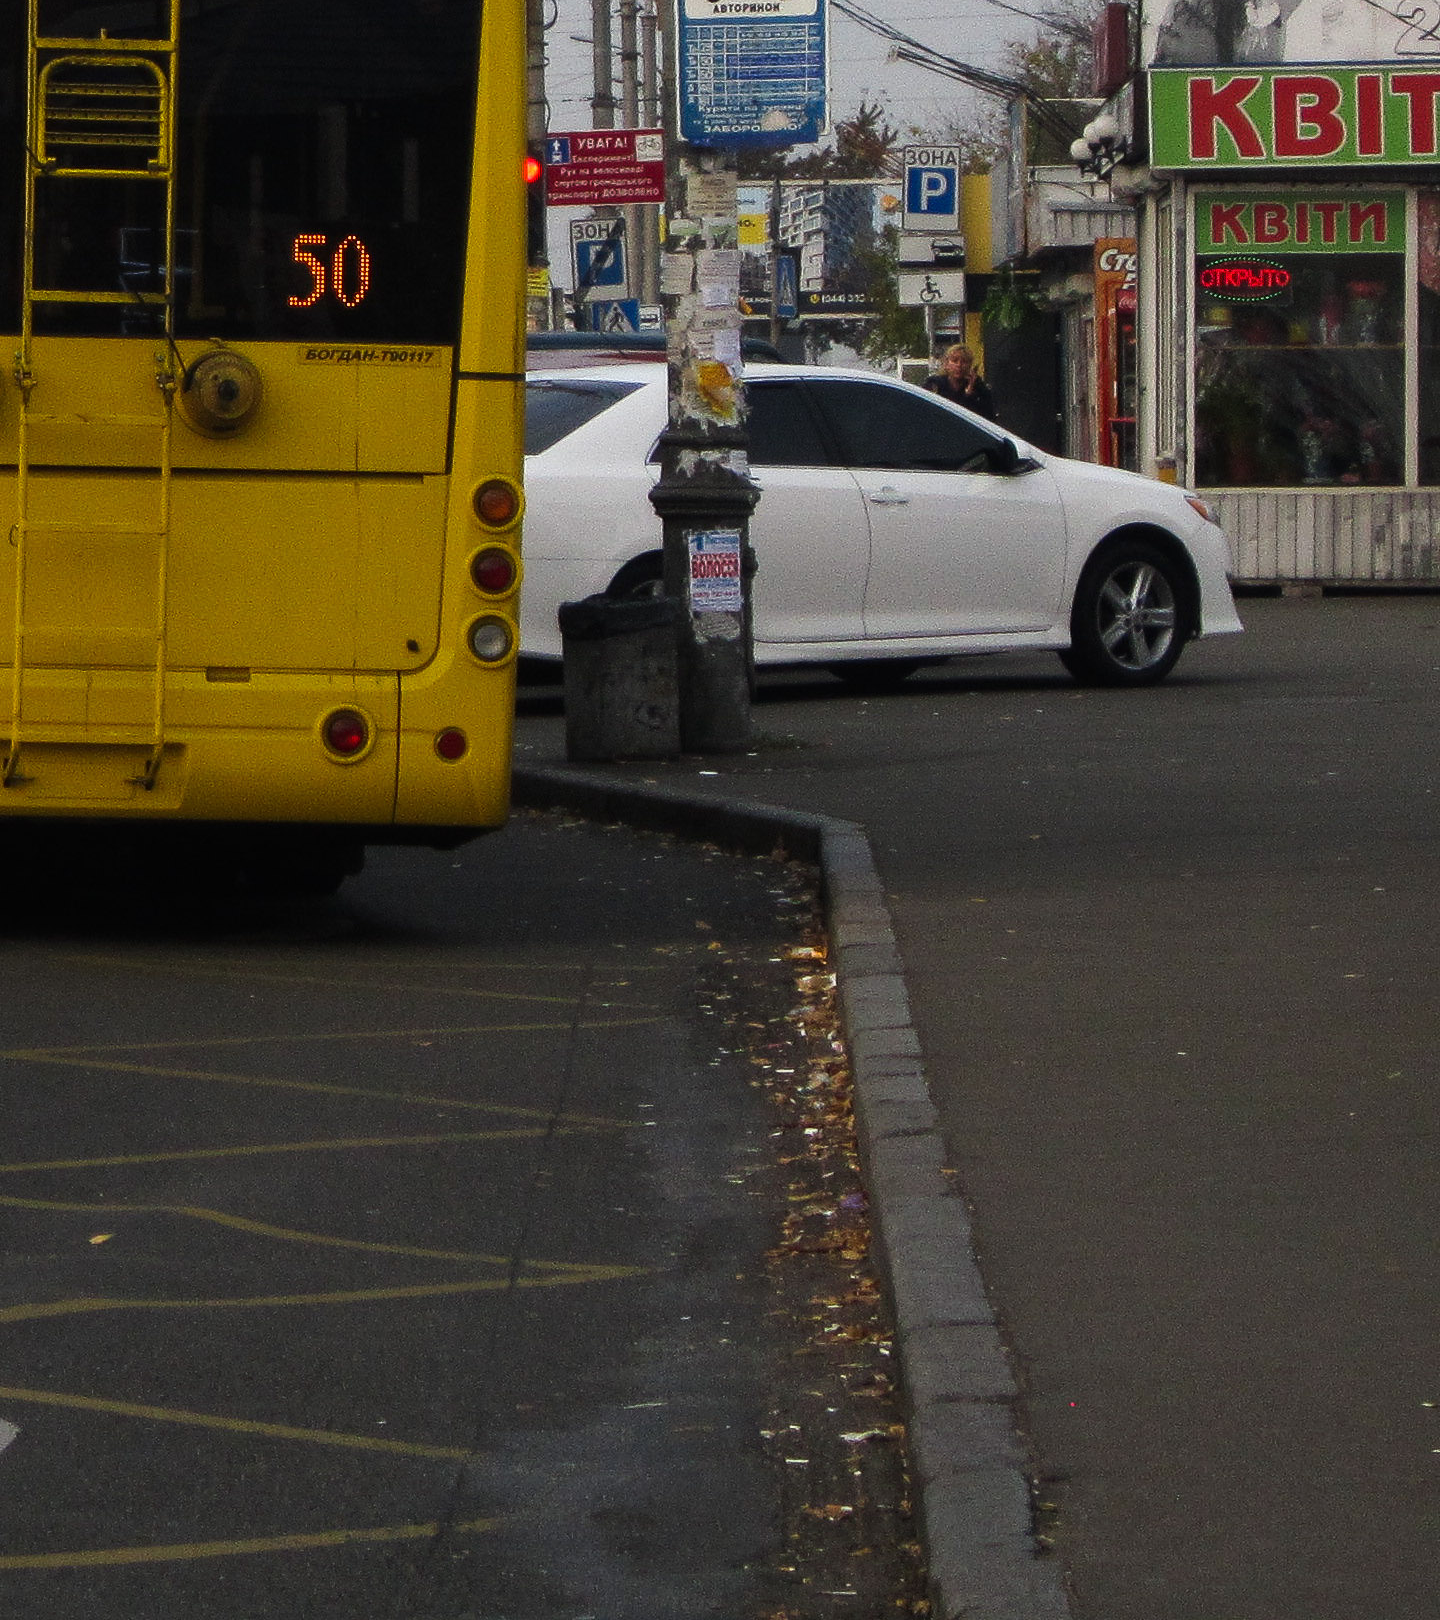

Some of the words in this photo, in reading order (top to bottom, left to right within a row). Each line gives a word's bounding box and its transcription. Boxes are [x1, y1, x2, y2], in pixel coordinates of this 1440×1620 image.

[1188, 73, 1440, 160] КВІТ
[577, 137, 628, 149] УВАГА!
[906, 150, 958, 165] ЗОНА
[1210, 201, 1388, 244] КВІТИ
[288, 234, 370, 307] 50
[1201, 268, 1290, 287] ОТКРЫТО
